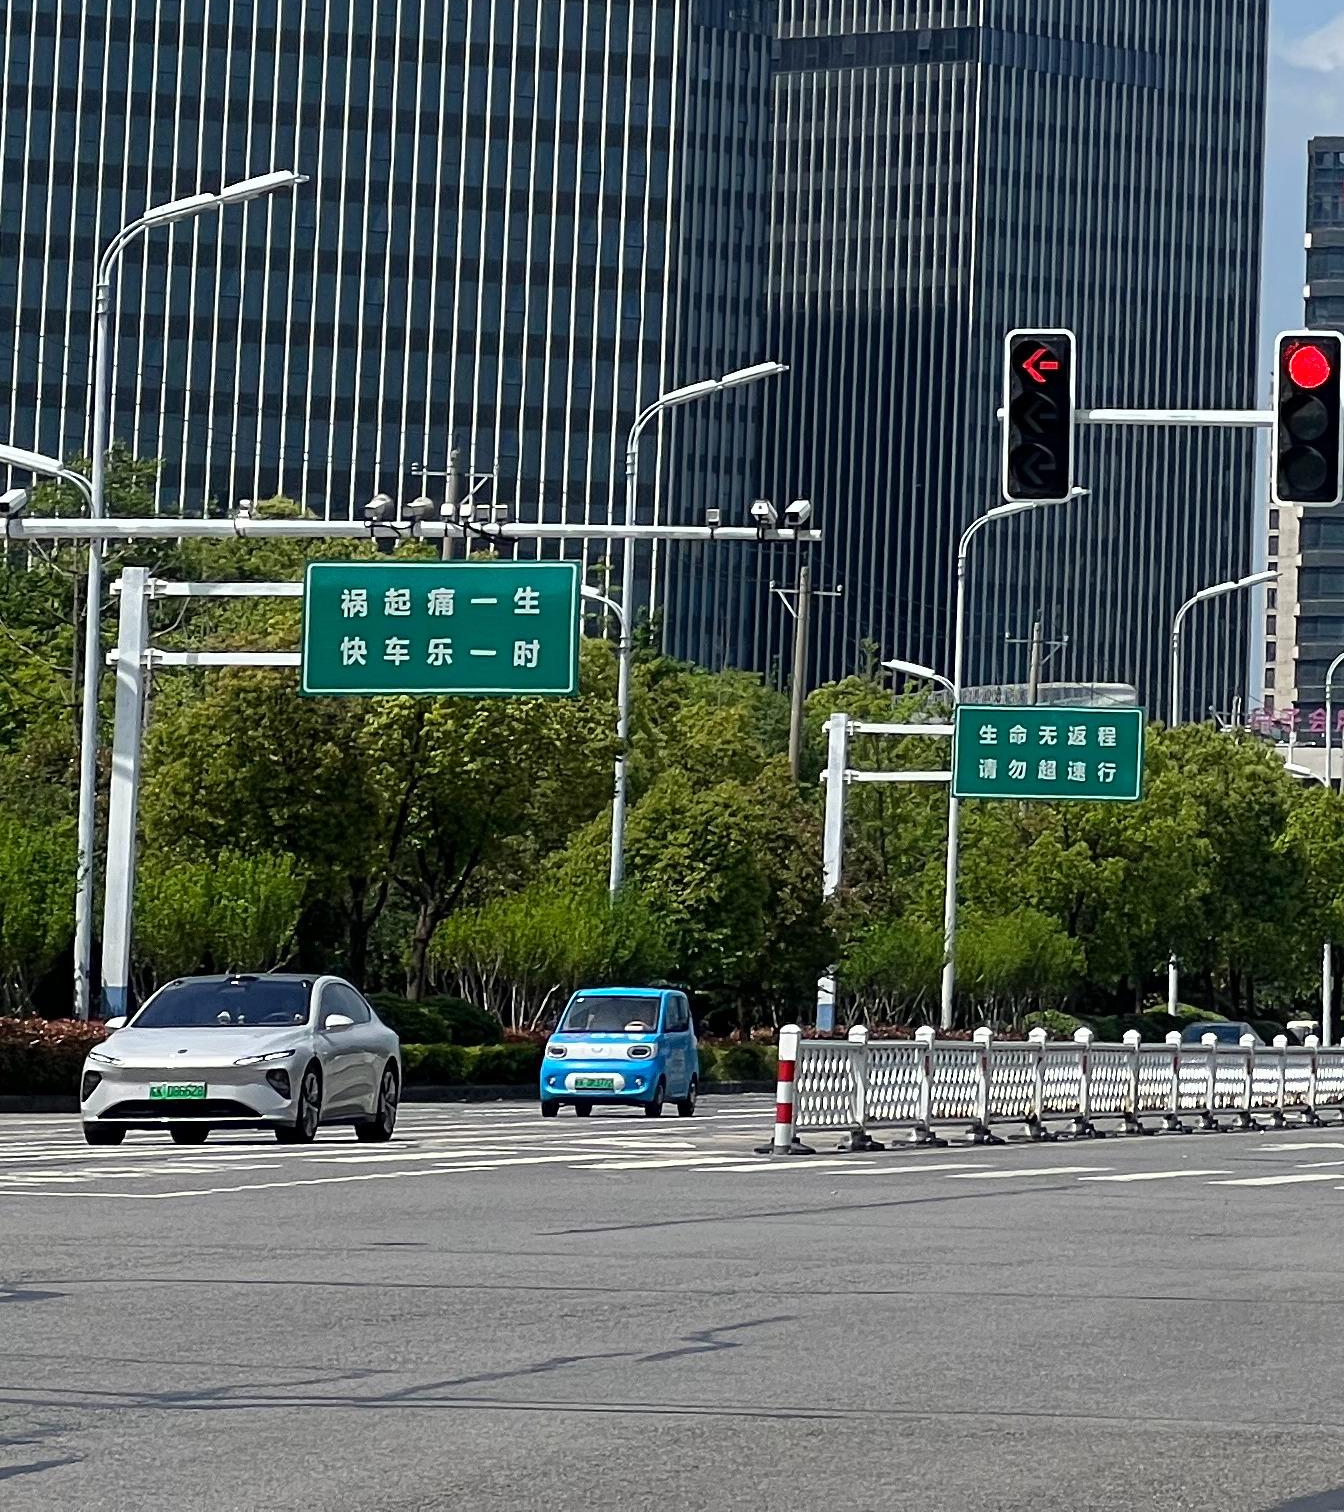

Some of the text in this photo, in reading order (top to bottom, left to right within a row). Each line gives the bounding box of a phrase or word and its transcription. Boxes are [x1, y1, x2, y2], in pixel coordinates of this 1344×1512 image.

[341, 586, 540, 618] 祸起痛一生
[340, 636, 540, 668] 快车乐一时
[979, 724, 1117, 747] 生命无返程
[978, 758, 1117, 783] 请勿超速行
